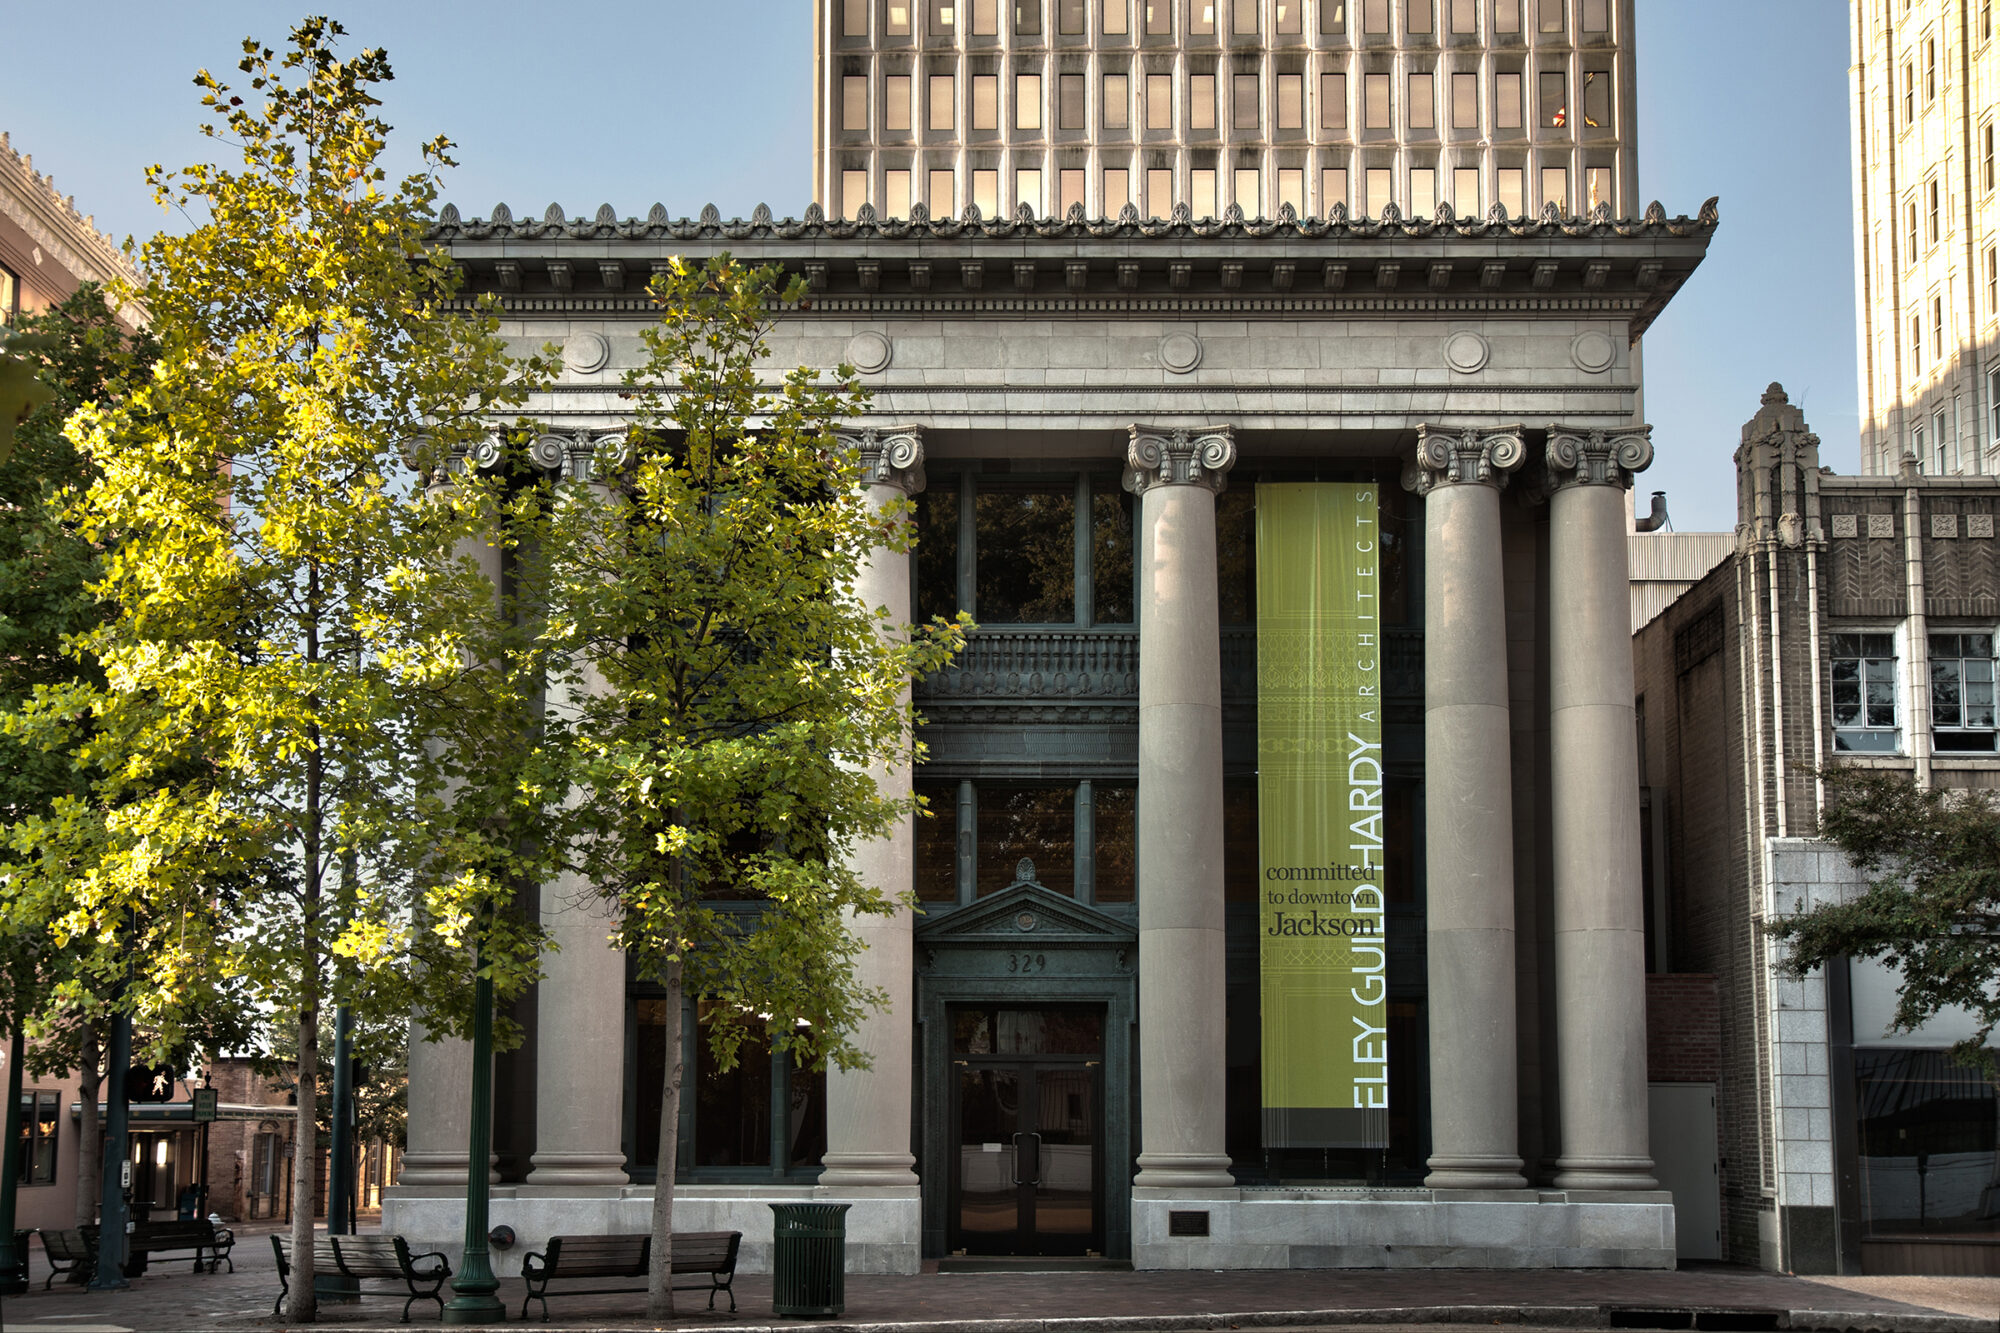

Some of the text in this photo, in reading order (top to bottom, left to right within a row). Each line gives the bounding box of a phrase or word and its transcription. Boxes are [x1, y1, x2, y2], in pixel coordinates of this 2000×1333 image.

[1348, 490, 1388, 1109] ELEY GUILD HARDY ARCHITECTS
[1266, 861, 1376, 881] committed
[1267, 888, 1376, 905] to downtown
[1268, 910, 1377, 937] Jackson
[1008, 954, 1046, 973] 329
